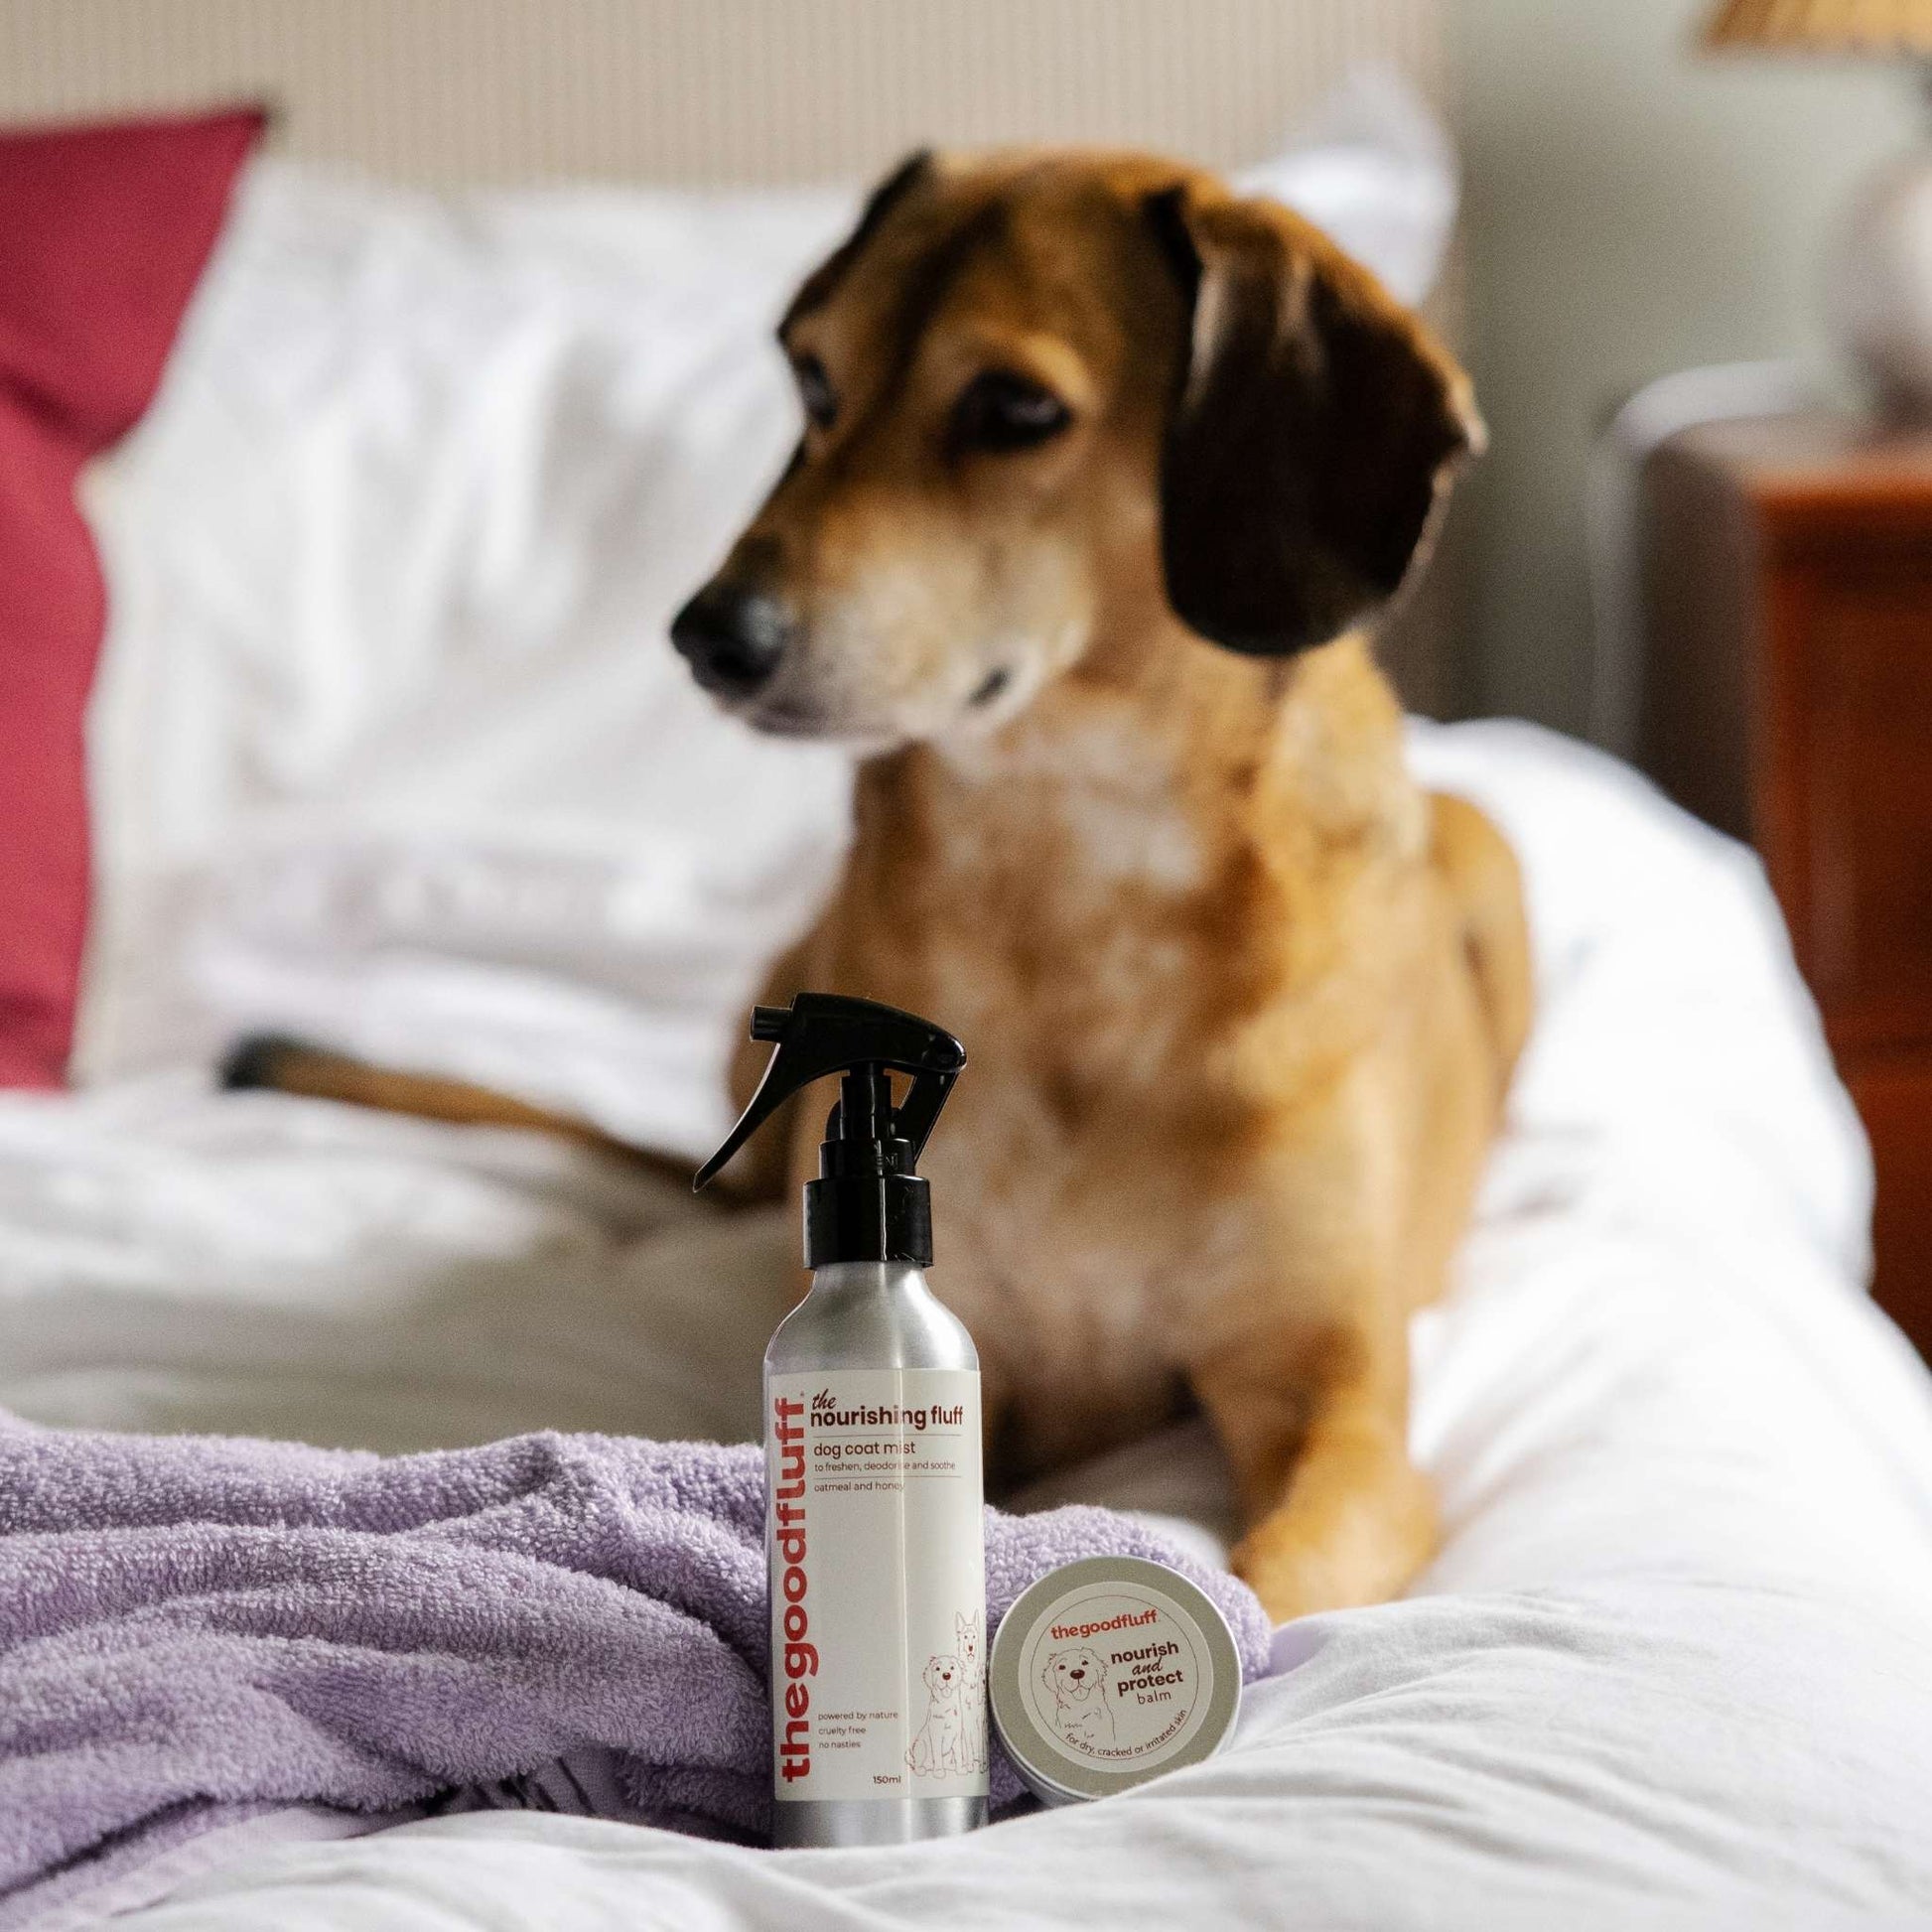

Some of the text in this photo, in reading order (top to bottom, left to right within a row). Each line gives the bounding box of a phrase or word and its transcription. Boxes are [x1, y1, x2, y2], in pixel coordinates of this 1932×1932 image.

[812, 1388, 836, 1410] the
[810, 1405, 963, 1430] nourishing fluff
[813, 1441, 915, 1459] dog coat mist
[825, 1461, 862, 1471] freshen,
[864, 1460, 909, 1471] deodorie
[912, 1460, 928, 1469] and
[930, 1460, 955, 1469] soothe
[814, 1481, 905, 1492] oatmeal and honey
[774, 1397, 819, 1783] thegoodfluff
[1050, 1609, 1158, 1640] thegoodfluff
[1111, 1641, 1179, 1664] nourish
[1132, 1655, 1164, 1676] and
[1117, 1669, 1184, 1697] protect
[1137, 1691, 1172, 1705] balm
[818, 1712, 854, 1721] powered
[856, 1710, 867, 1721] by
[818, 1725, 866, 1736] cruelty free
[1065, 1732, 1079, 1744] for
[1079, 1742, 1095, 1755] dry,
[1097, 1747, 1132, 1756] cracked
[1146, 1724, 1176, 1749] irritated
[1173, 1709, 1187, 1725] skin
[831, 1740, 861, 1749] nasties
[873, 1775, 900, 1784] 150ml
